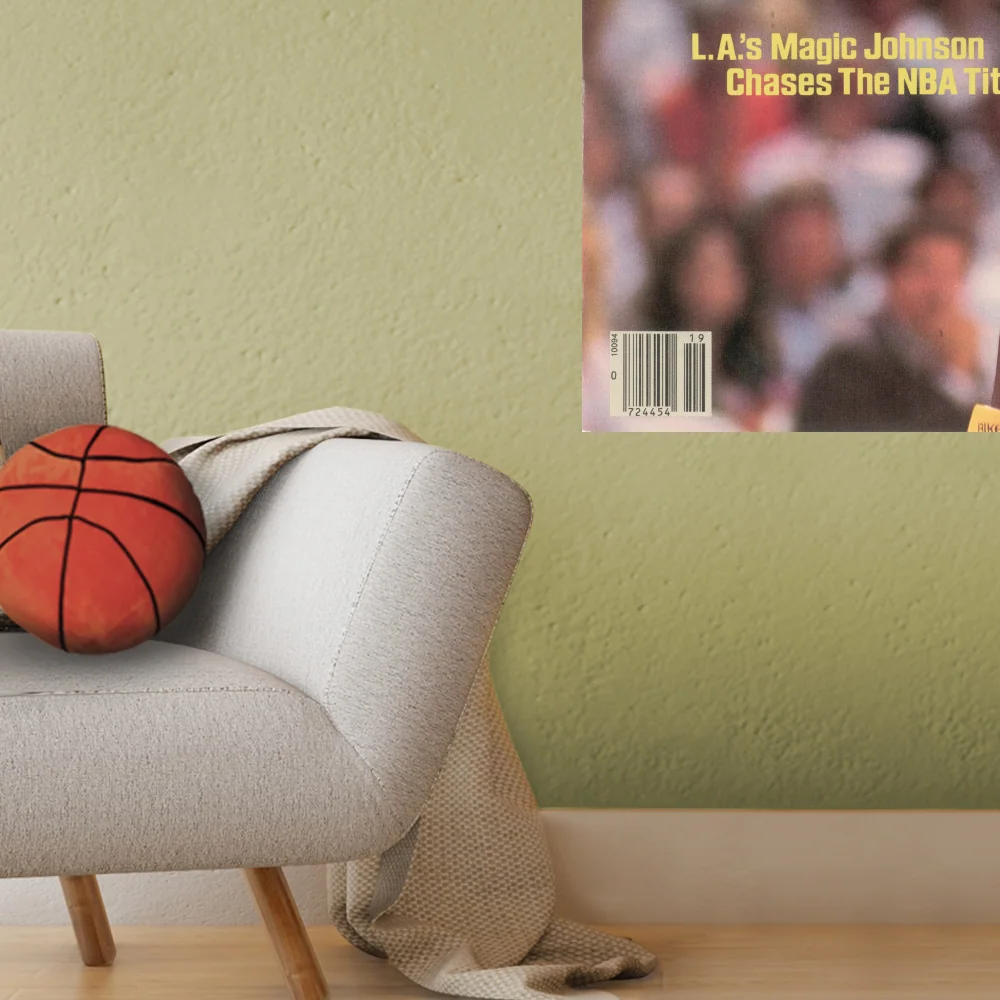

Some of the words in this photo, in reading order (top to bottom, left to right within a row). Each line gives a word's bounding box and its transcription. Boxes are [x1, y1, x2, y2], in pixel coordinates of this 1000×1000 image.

[691, 32, 762, 61] L.A.'s
[770, 32, 857, 65] Magic
[863, 32, 985, 60] Johnson
[726, 67, 832, 96] Chases
[837, 67, 889, 95] The
[897, 67, 958, 95] NBA
[610, 333, 619, 357] 10094
[628, 407, 671, 417] 724454
